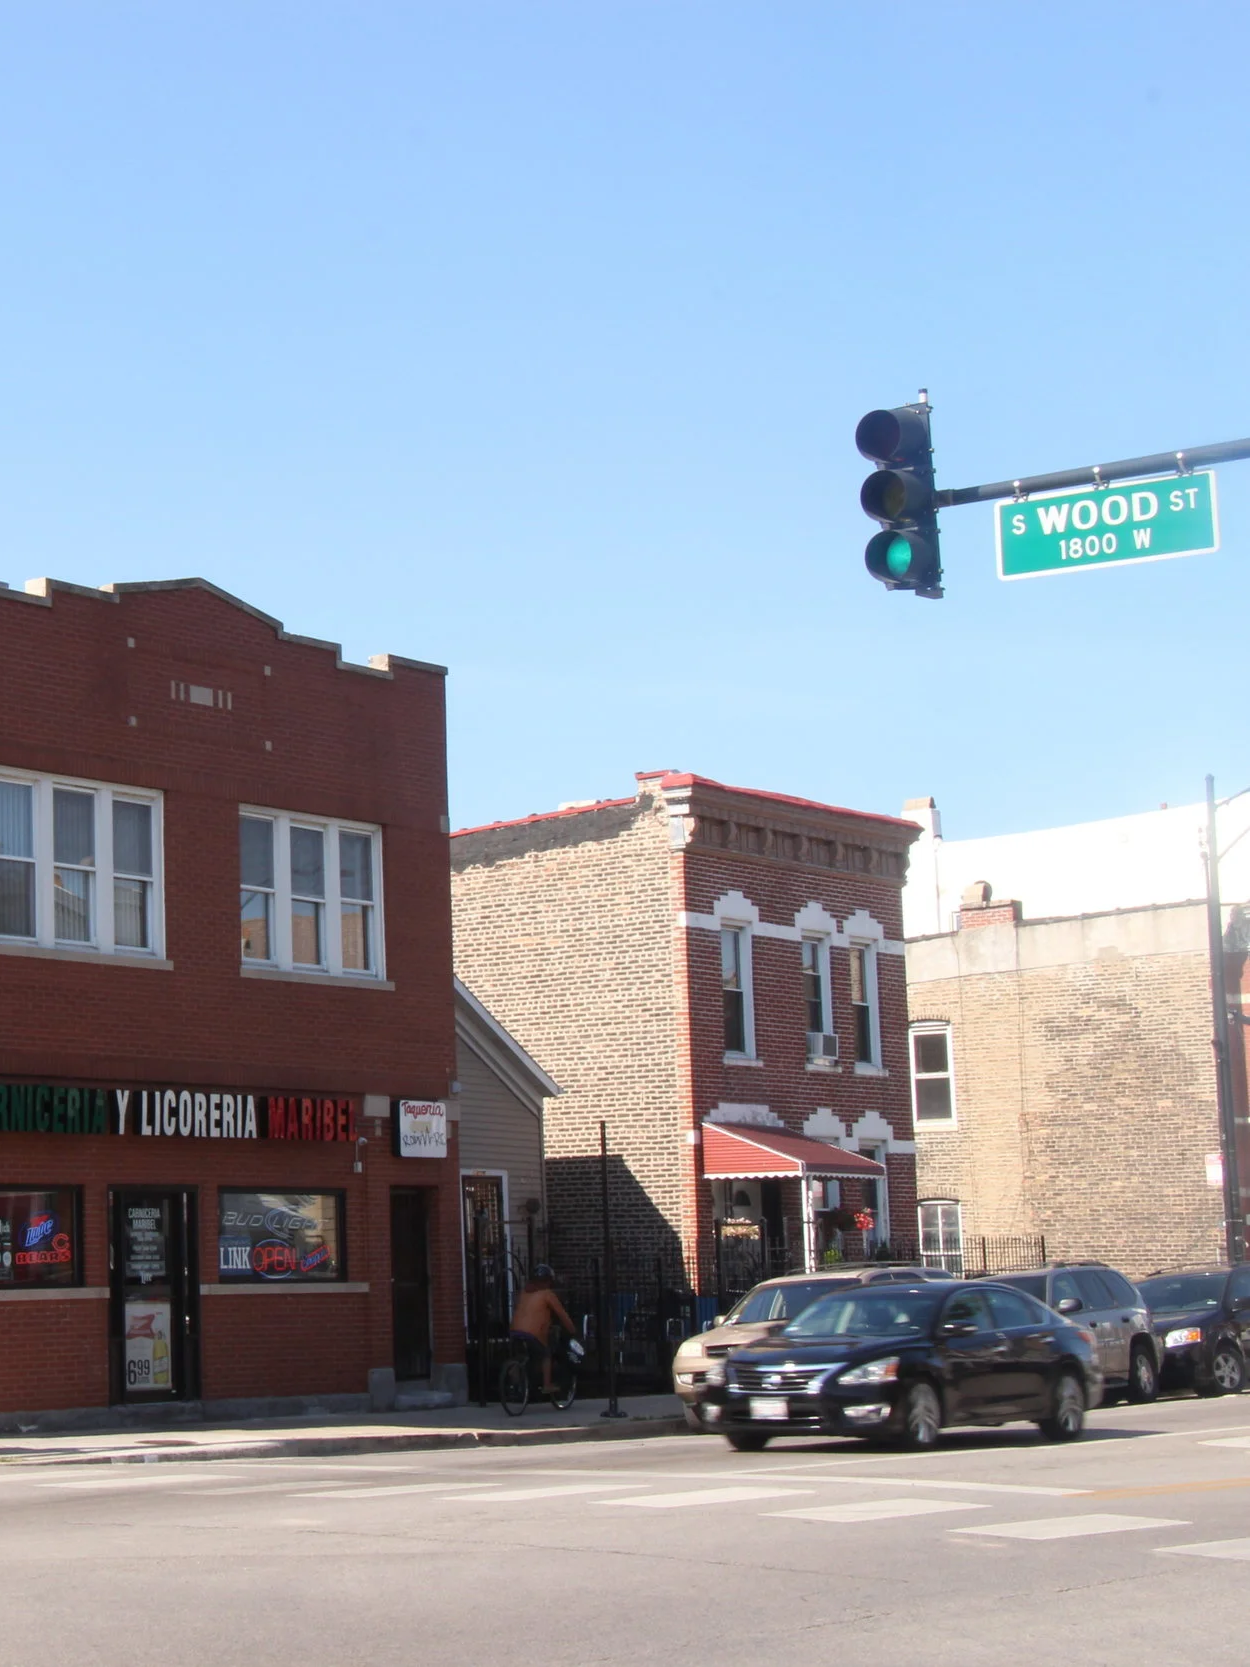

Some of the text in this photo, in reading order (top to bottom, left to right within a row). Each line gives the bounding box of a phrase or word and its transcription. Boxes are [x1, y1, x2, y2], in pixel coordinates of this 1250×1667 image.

[1012, 487, 1199, 536] S WOOD ST
[1059, 527, 1152, 560] 1800 W
[115, 1089, 130, 1135] Y
[141, 1089, 258, 1139] LICORERIA
[268, 1096, 358, 1142] MARIBEL
[401, 1101, 444, 1120] Taqueria
[222, 1211, 263, 1227] BUD
[15, 1250, 71, 1265] BEARS
[220, 1246, 251, 1270] LINK
[253, 1247, 297, 1272] OPEN
